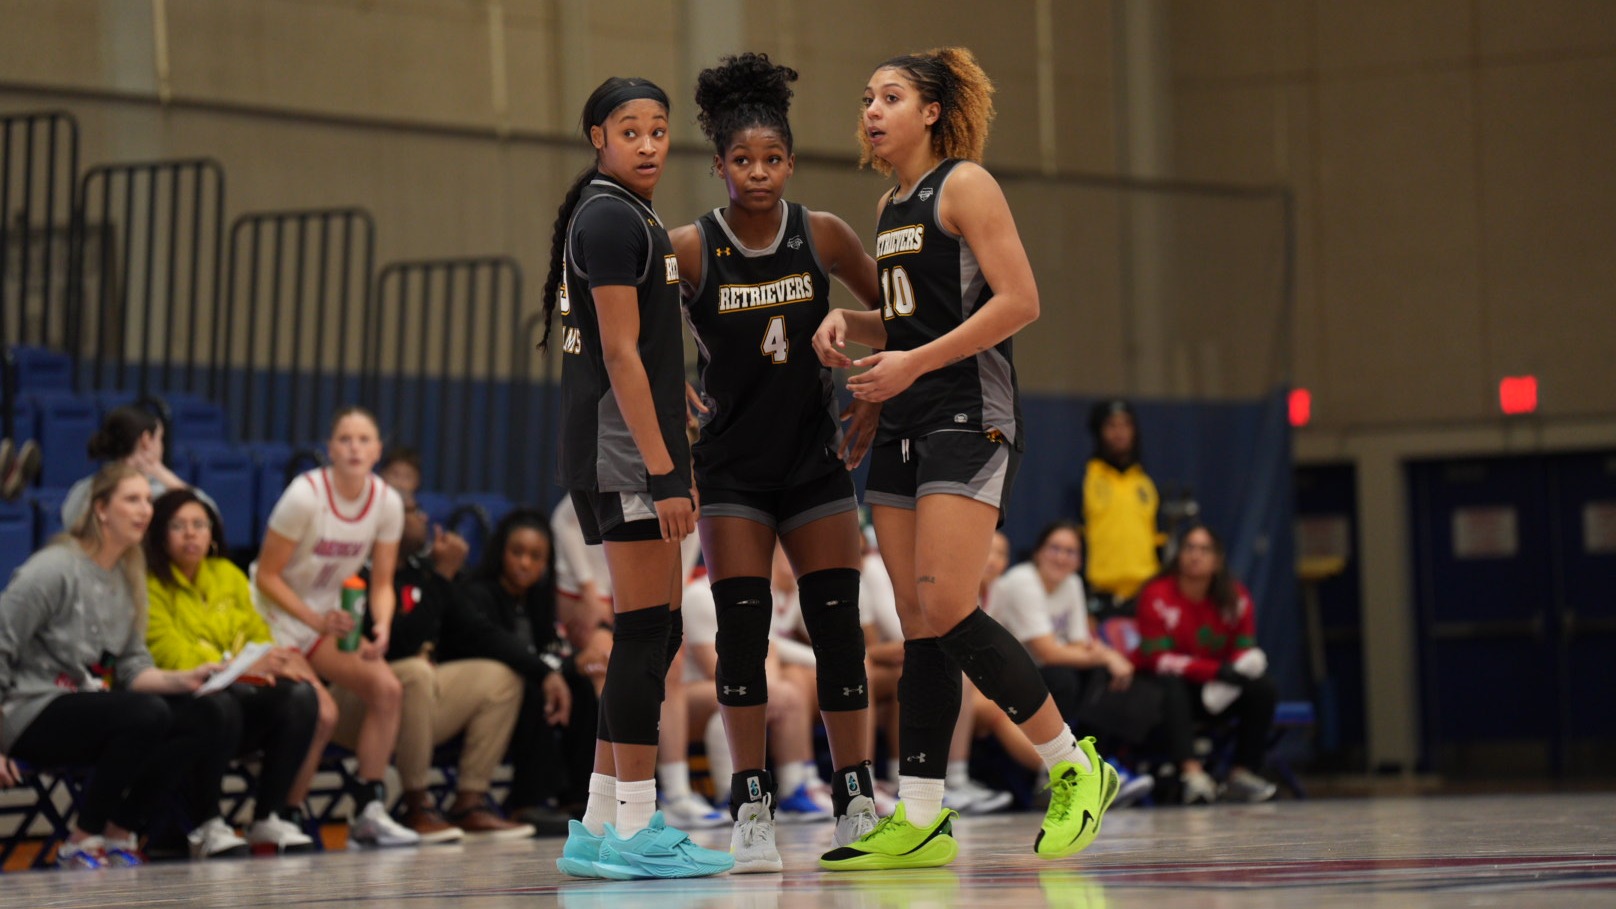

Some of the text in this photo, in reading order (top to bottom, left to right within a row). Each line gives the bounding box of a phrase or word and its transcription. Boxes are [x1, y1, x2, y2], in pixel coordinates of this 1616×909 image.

[718, 272, 814, 314] RETRIEVERS
[881, 266, 916, 320] 10
[761, 315, 789, 364] 4
